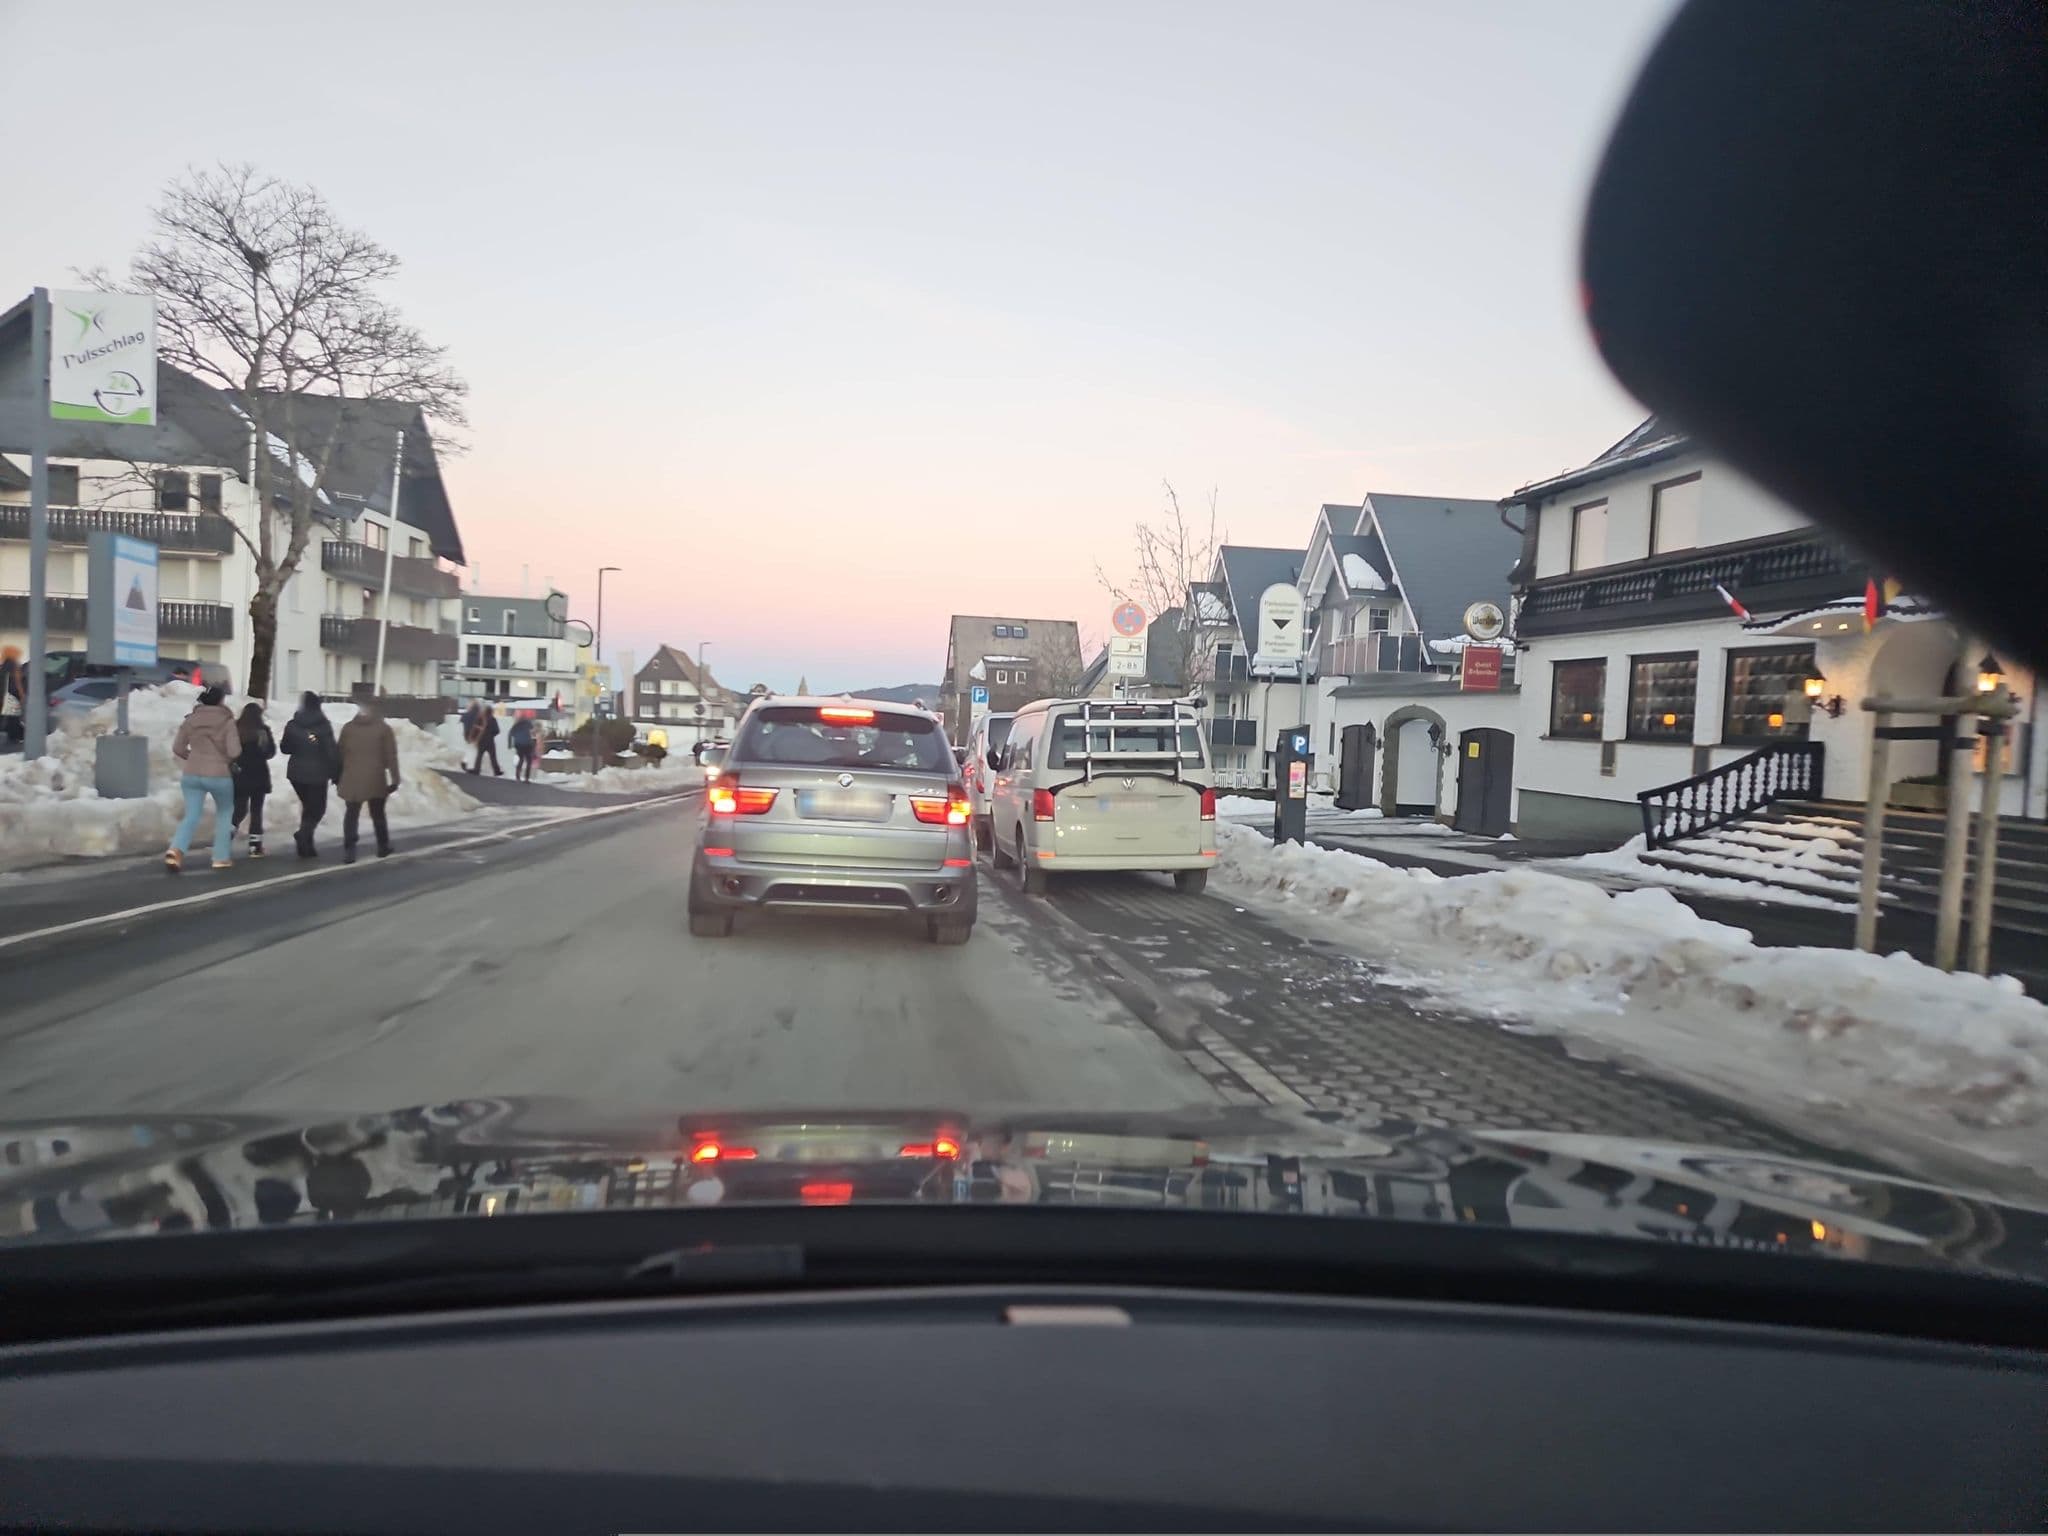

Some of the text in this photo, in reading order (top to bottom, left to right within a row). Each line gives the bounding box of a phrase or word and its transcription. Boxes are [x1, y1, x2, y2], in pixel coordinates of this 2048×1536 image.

[63, 331, 145, 369] Pulsschlag
[975, 688, 985, 701] P
[1295, 736, 1306, 752] P
